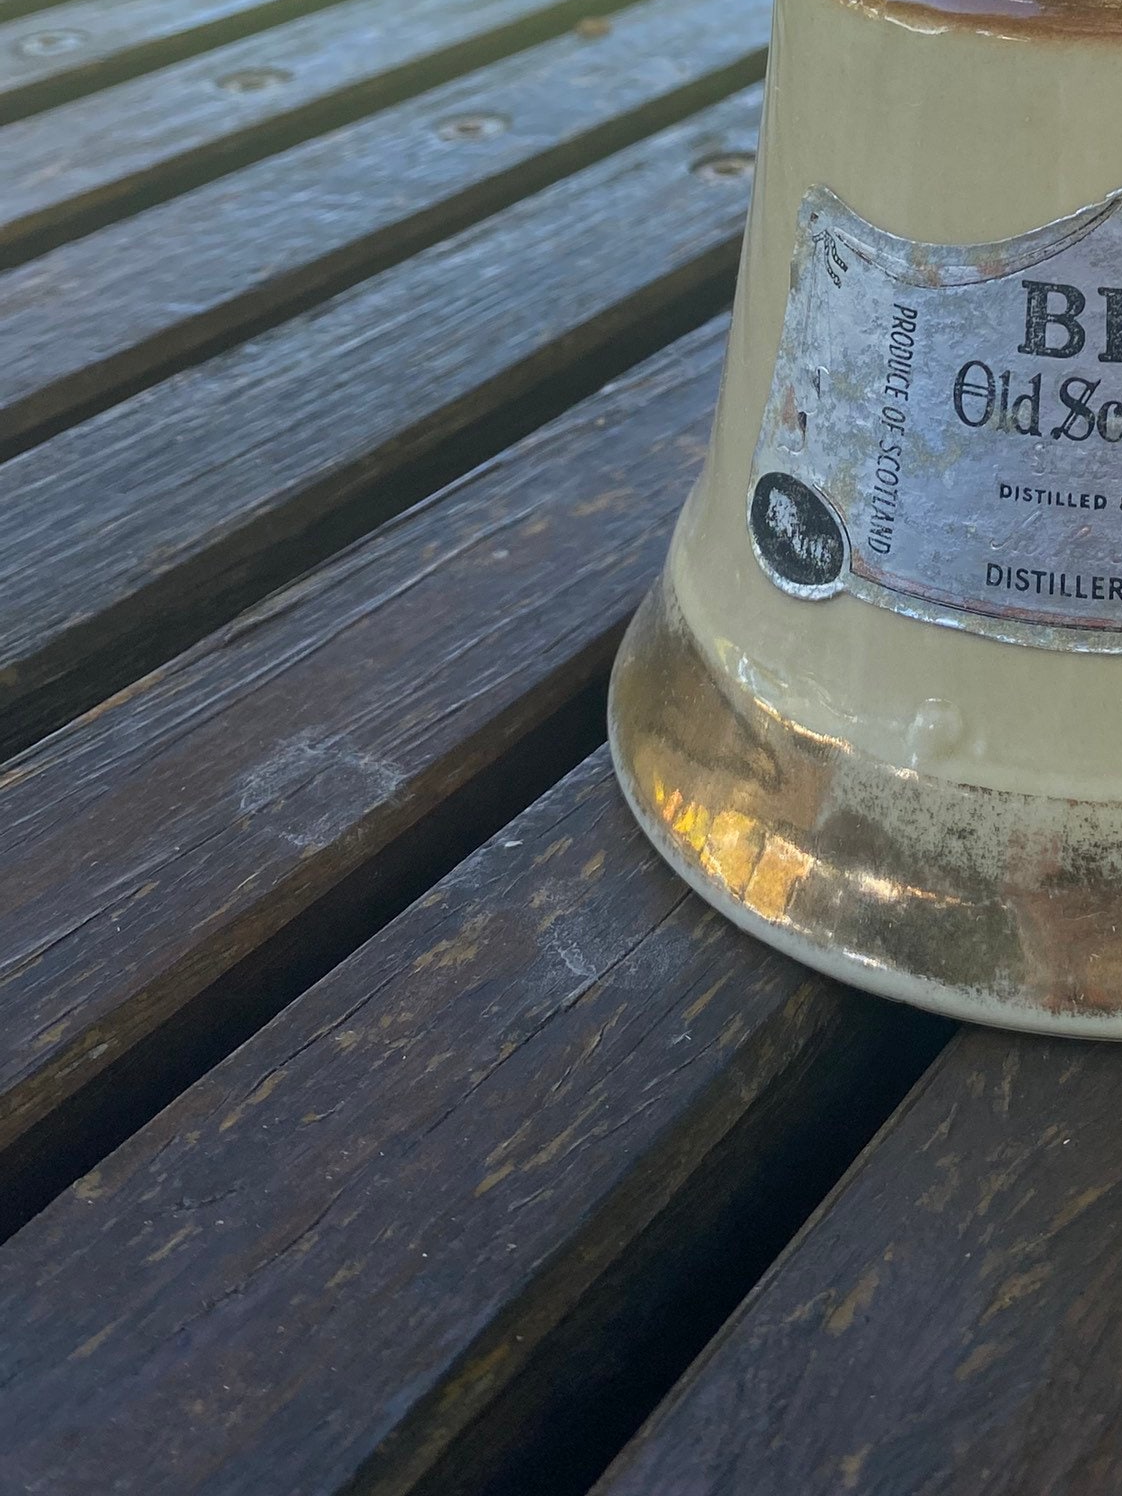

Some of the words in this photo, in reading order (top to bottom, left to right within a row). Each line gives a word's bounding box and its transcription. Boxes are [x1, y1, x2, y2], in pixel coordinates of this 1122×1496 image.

[885, 303, 918, 401] PRODUCE
[881, 406, 906, 436] OF
[953, 360, 1042, 437] Old
[868, 440, 902, 554] SCOTLAND
[1000, 483, 1107, 510] DISTILLED
